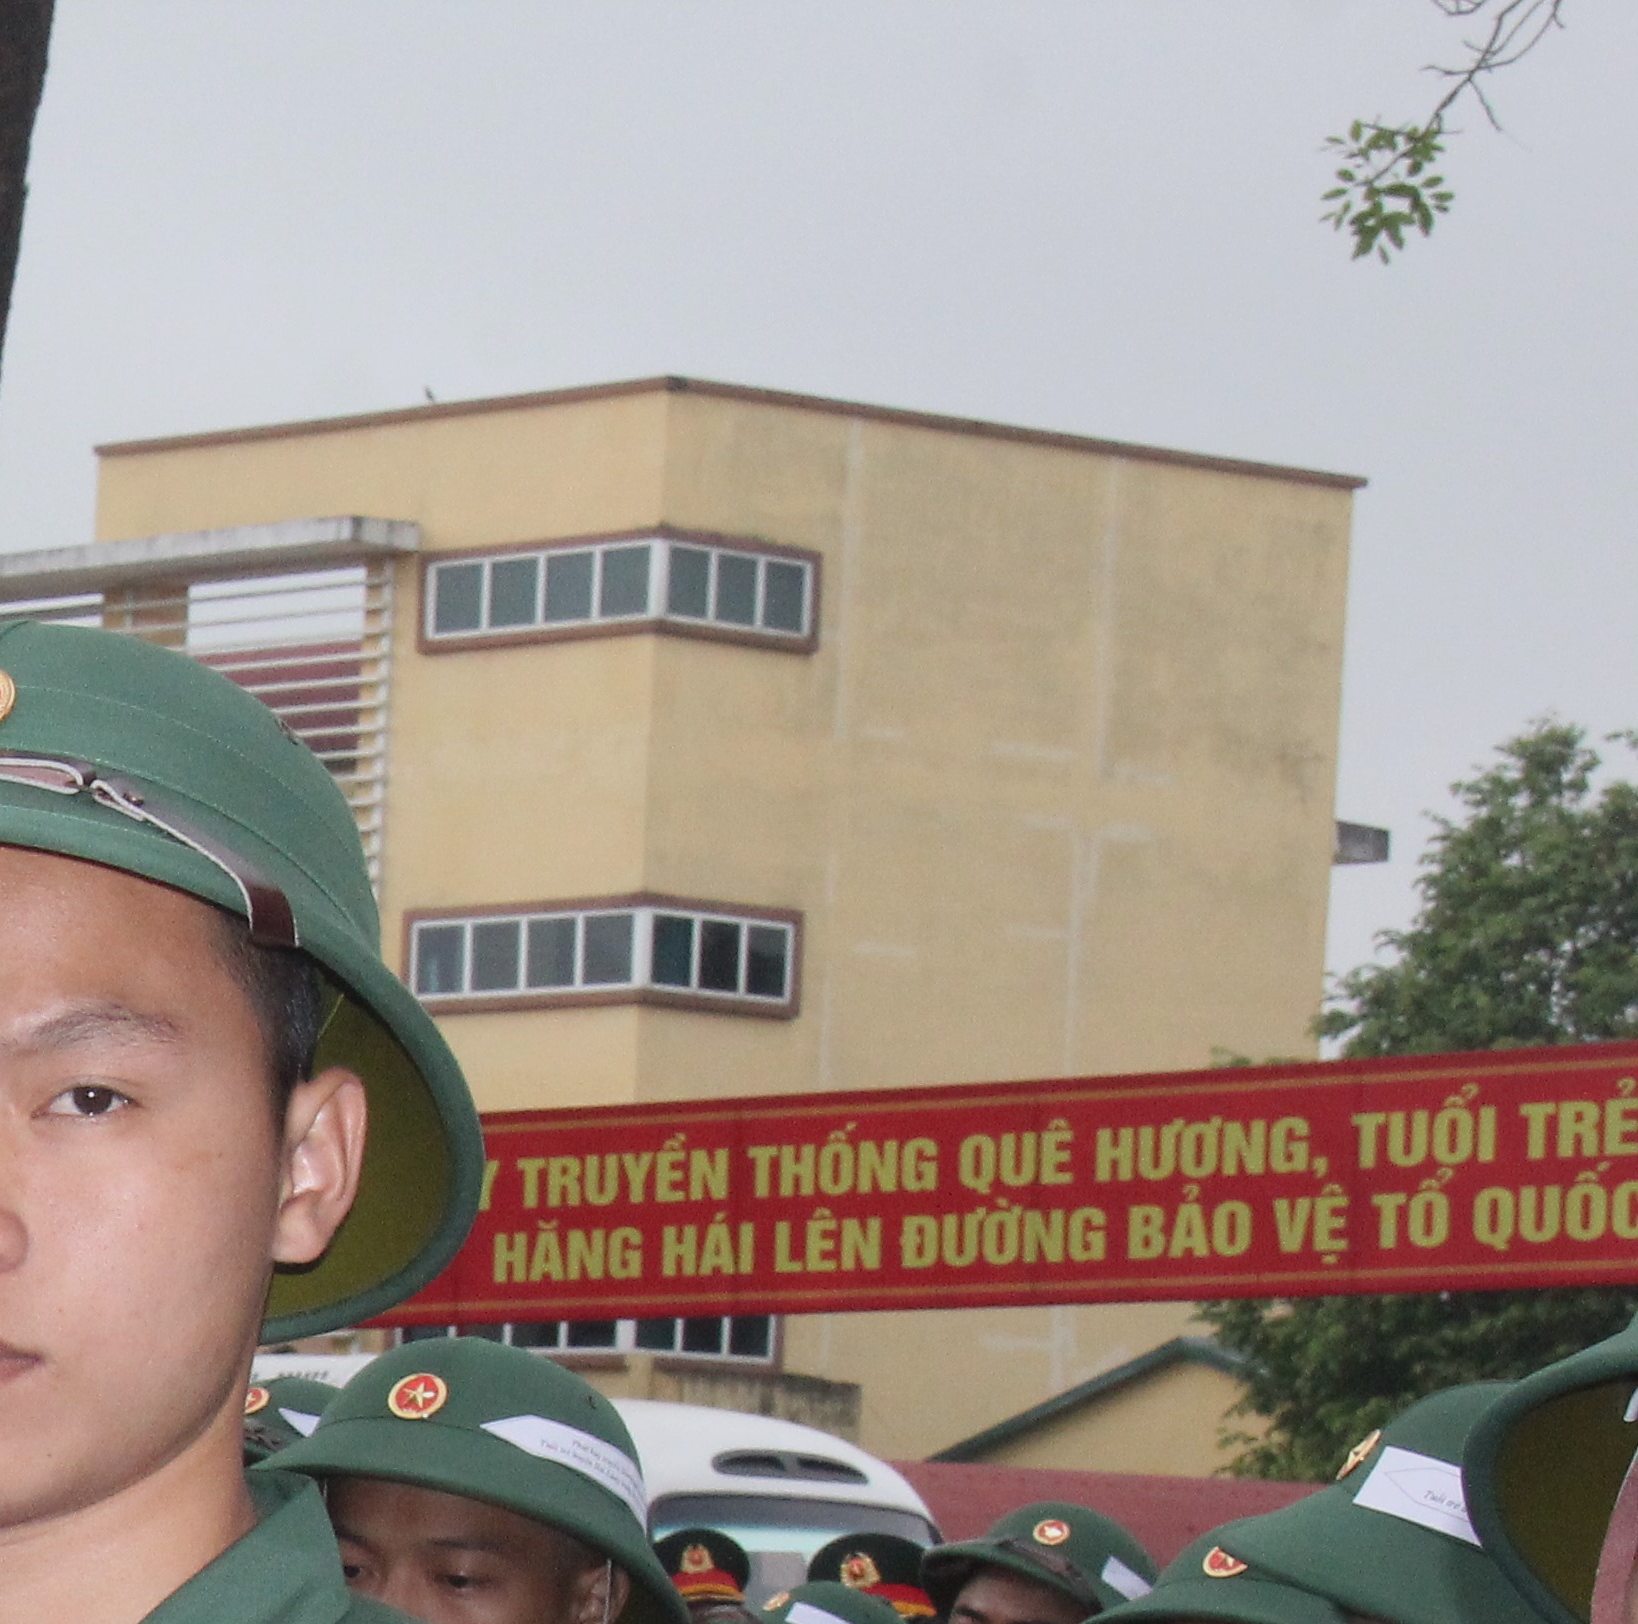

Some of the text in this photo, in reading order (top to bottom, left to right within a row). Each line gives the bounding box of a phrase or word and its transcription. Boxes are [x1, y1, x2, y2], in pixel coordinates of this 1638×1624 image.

[516, 1133, 730, 1209] TRUYỀN
[748, 1121, 938, 1197] THỐNG
[959, 1118, 1074, 1194] QUÊ
[1095, 1115, 1328, 1183] HƯƠNG,
[1351, 1083, 1497, 1169] TUỔI
[1519, 1077, 1638, 1160] TRẺ
[492, 1161, 1638, 1283] HĂNG HÁI LÊN ĐƯỜNG BẢO VỆ TỔ QUỐC
